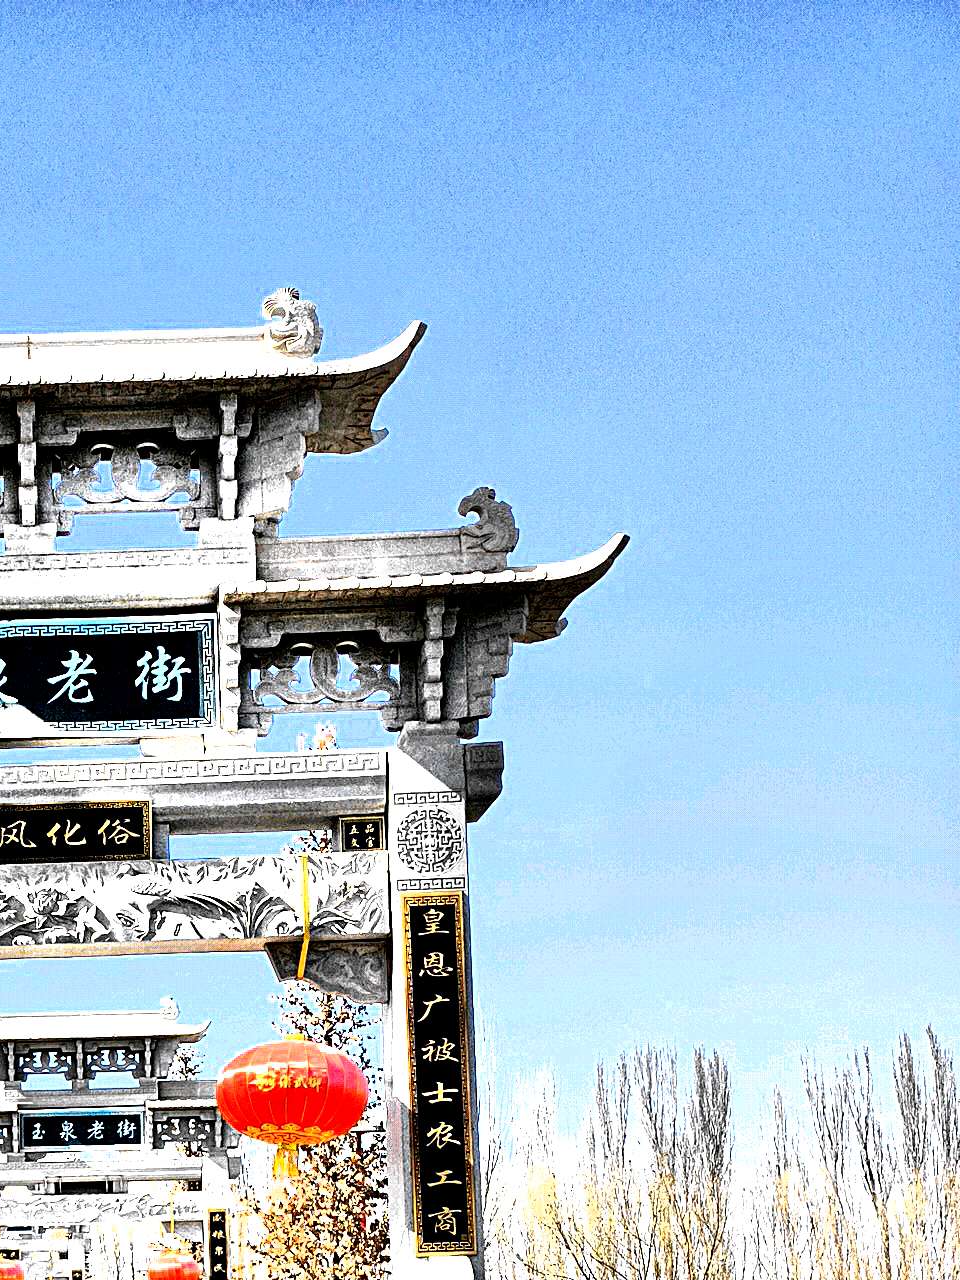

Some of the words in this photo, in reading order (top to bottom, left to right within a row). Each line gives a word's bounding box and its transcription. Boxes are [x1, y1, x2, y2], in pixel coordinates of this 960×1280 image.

[31, 1118, 137, 1142] 玉泉老街
[417, 908, 462, 1236] 皇恩广被士农工商
